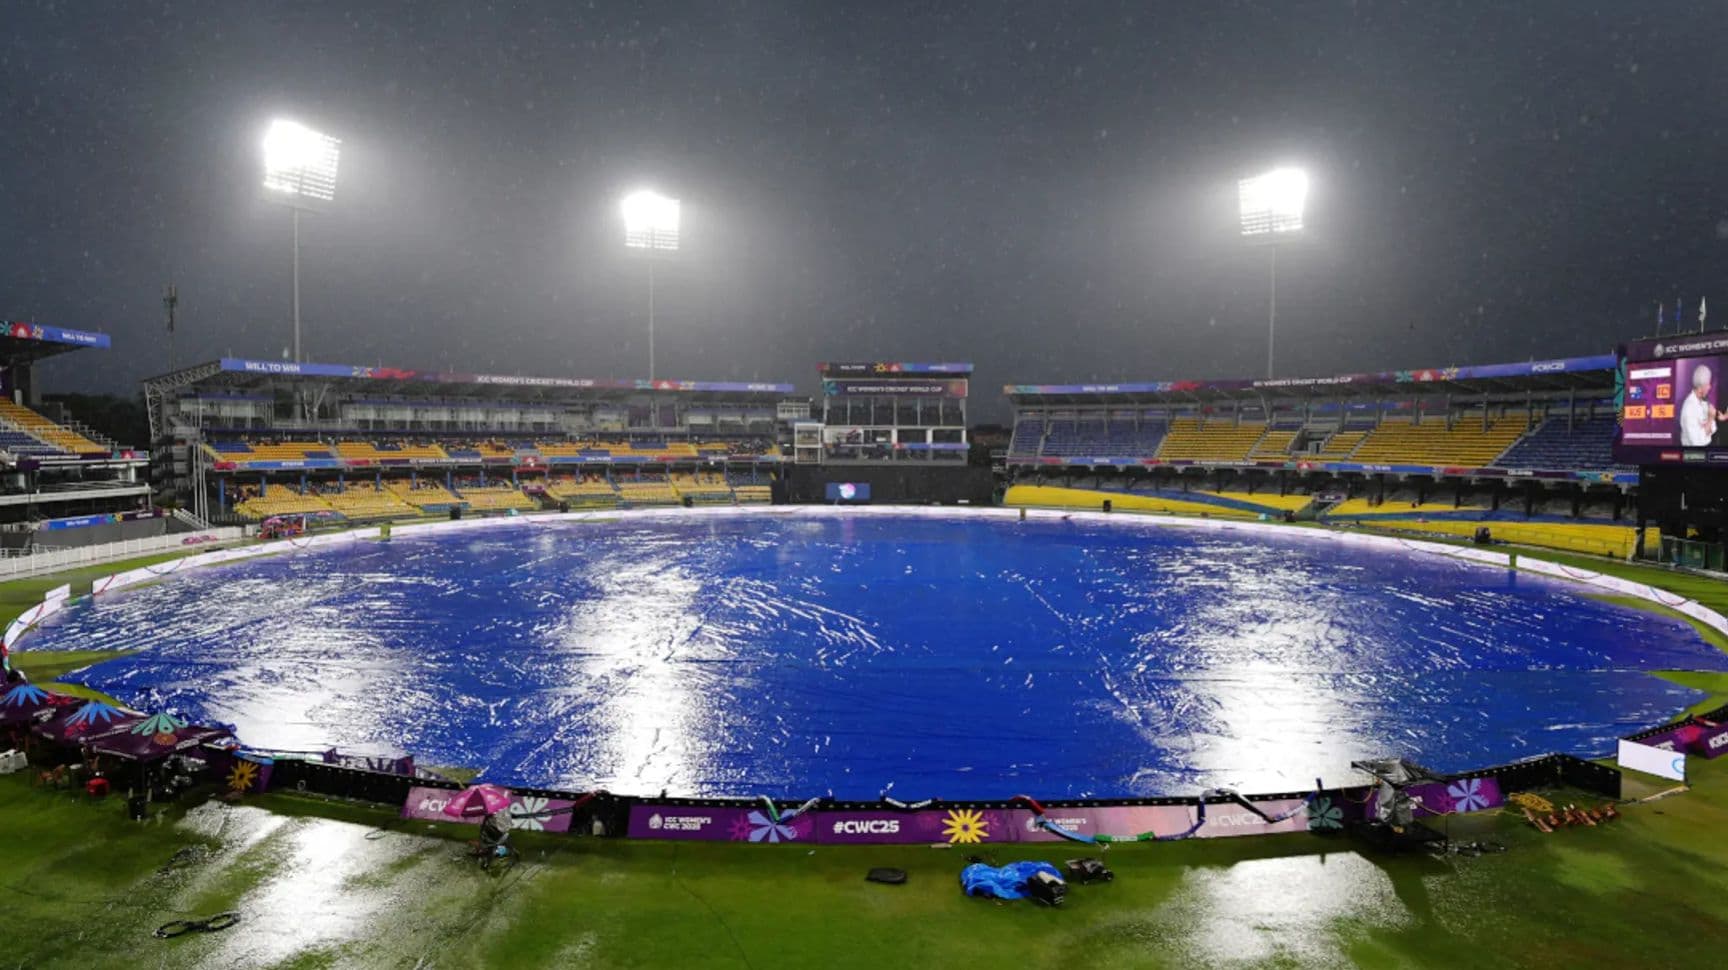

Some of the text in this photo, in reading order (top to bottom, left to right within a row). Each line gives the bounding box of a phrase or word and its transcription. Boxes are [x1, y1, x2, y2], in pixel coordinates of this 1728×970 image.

[1678, 342, 1713, 352] WOMEN'S
[245, 361, 301, 373] WILL TO WIN
[477, 375, 594, 387] ICC WOMEN'S CRICKET WORLD CUP
[664, 816, 712, 825] ICC WOMEN'S
[833, 819, 900, 834] #CWC25
